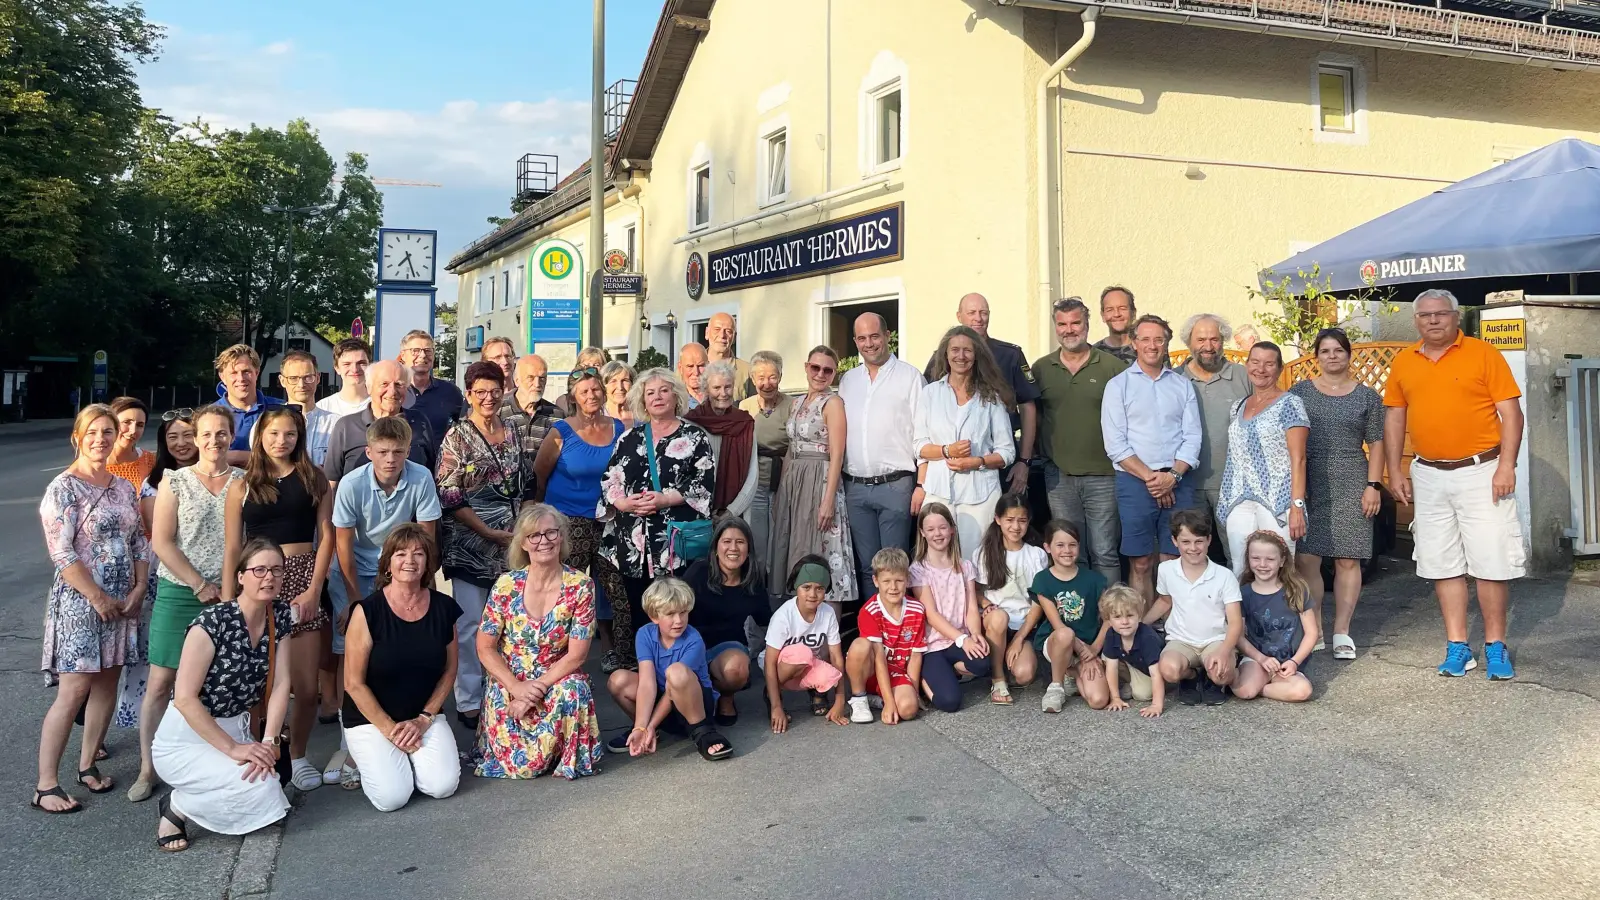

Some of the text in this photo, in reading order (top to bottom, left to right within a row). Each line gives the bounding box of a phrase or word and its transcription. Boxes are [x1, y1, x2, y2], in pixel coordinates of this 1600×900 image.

[712, 217, 892, 282] RESTAURANT HERMES
[1381, 254, 1466, 279] PAULANER
[1486, 323, 1520, 333] Ausfahrt
